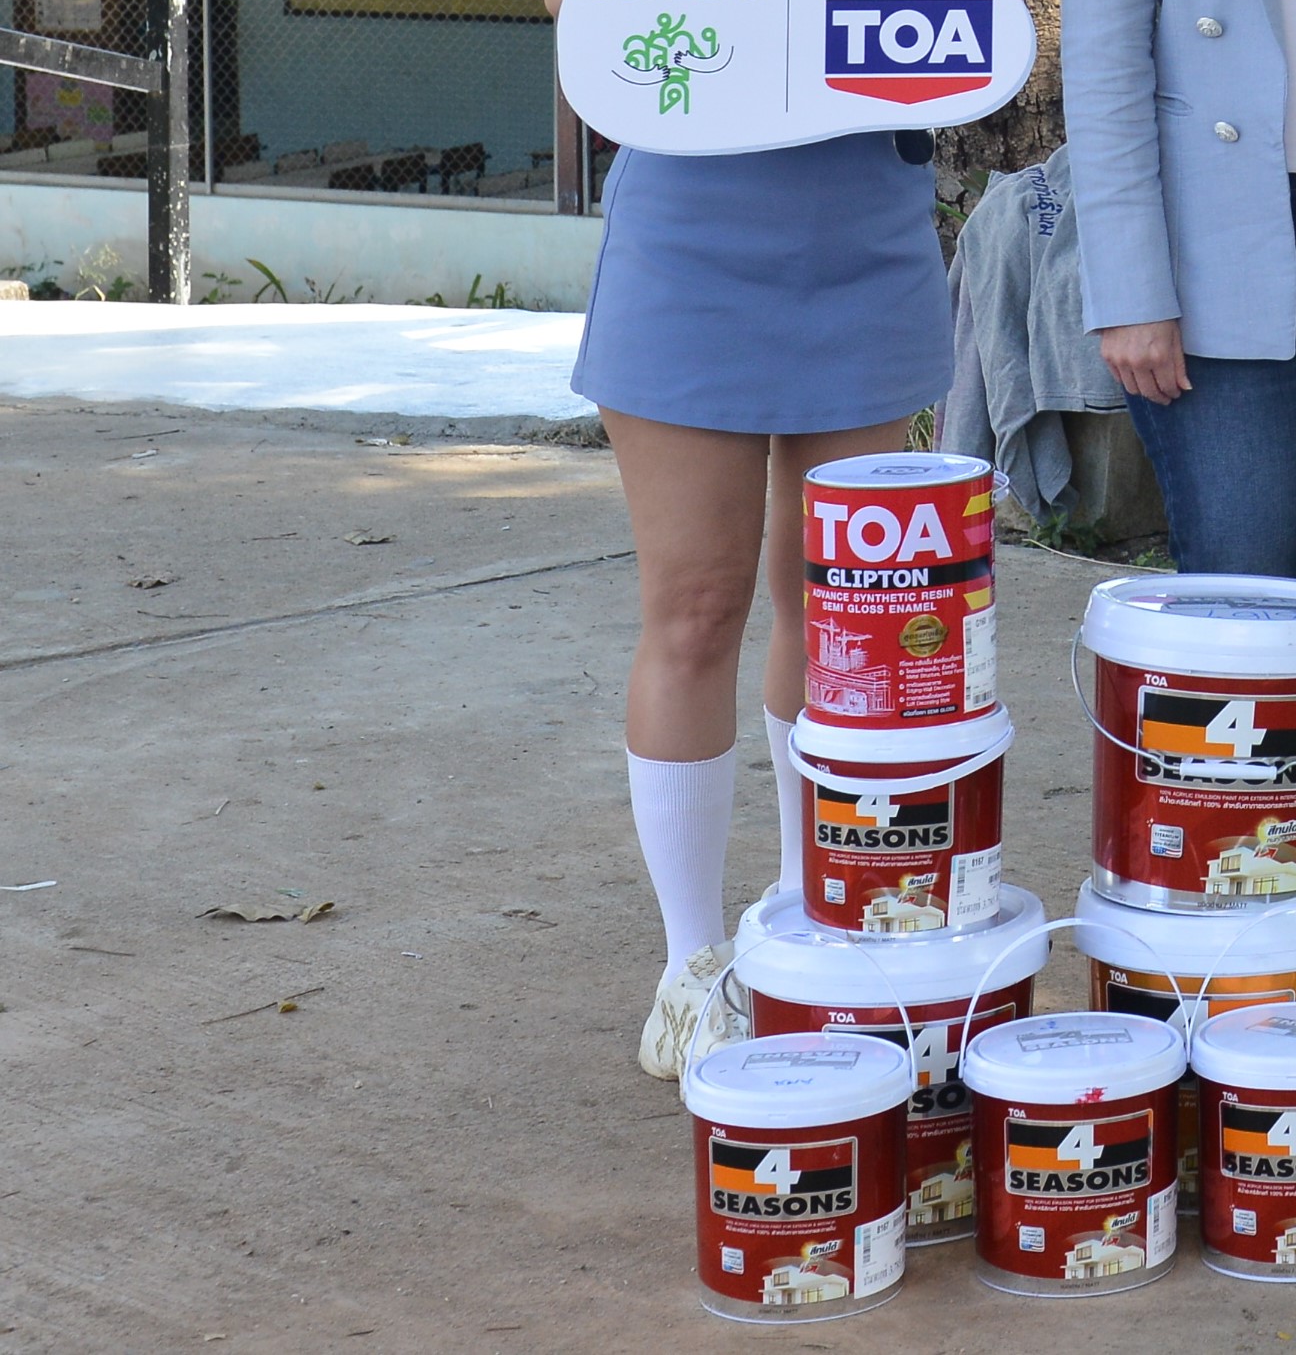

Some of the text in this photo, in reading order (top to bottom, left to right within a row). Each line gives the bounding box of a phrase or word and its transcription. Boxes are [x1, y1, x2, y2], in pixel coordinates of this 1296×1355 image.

[832, 9, 985, 64] TOA
[814, 501, 953, 563] TOA
[827, 567, 929, 589] GLIPTON
[812, 588, 954, 603] ADVANCE SYNTHETIC RESIN
[822, 601, 937, 614] SEMI GLOSS ENAMEL
[1144, 674, 1168, 687] TOA
[1205, 700, 1267, 758] 4
[856, 794, 900, 828] 4
[818, 823, 949, 848] SEASONS
[1109, 969, 1128, 985] TOA
[828, 1011, 856, 1024] TOA
[908, 1025, 960, 1086] 4
[1222, 1091, 1239, 1102] TOA
[1008, 1107, 1027, 1119] TOA
[711, 1126, 727, 1138] TOA
[1057, 1124, 1105, 1170] 4
[754, 1149, 802, 1195] 4
[1009, 1161, 1149, 1193] SEASONS
[713, 1190, 852, 1217] SEASONS
